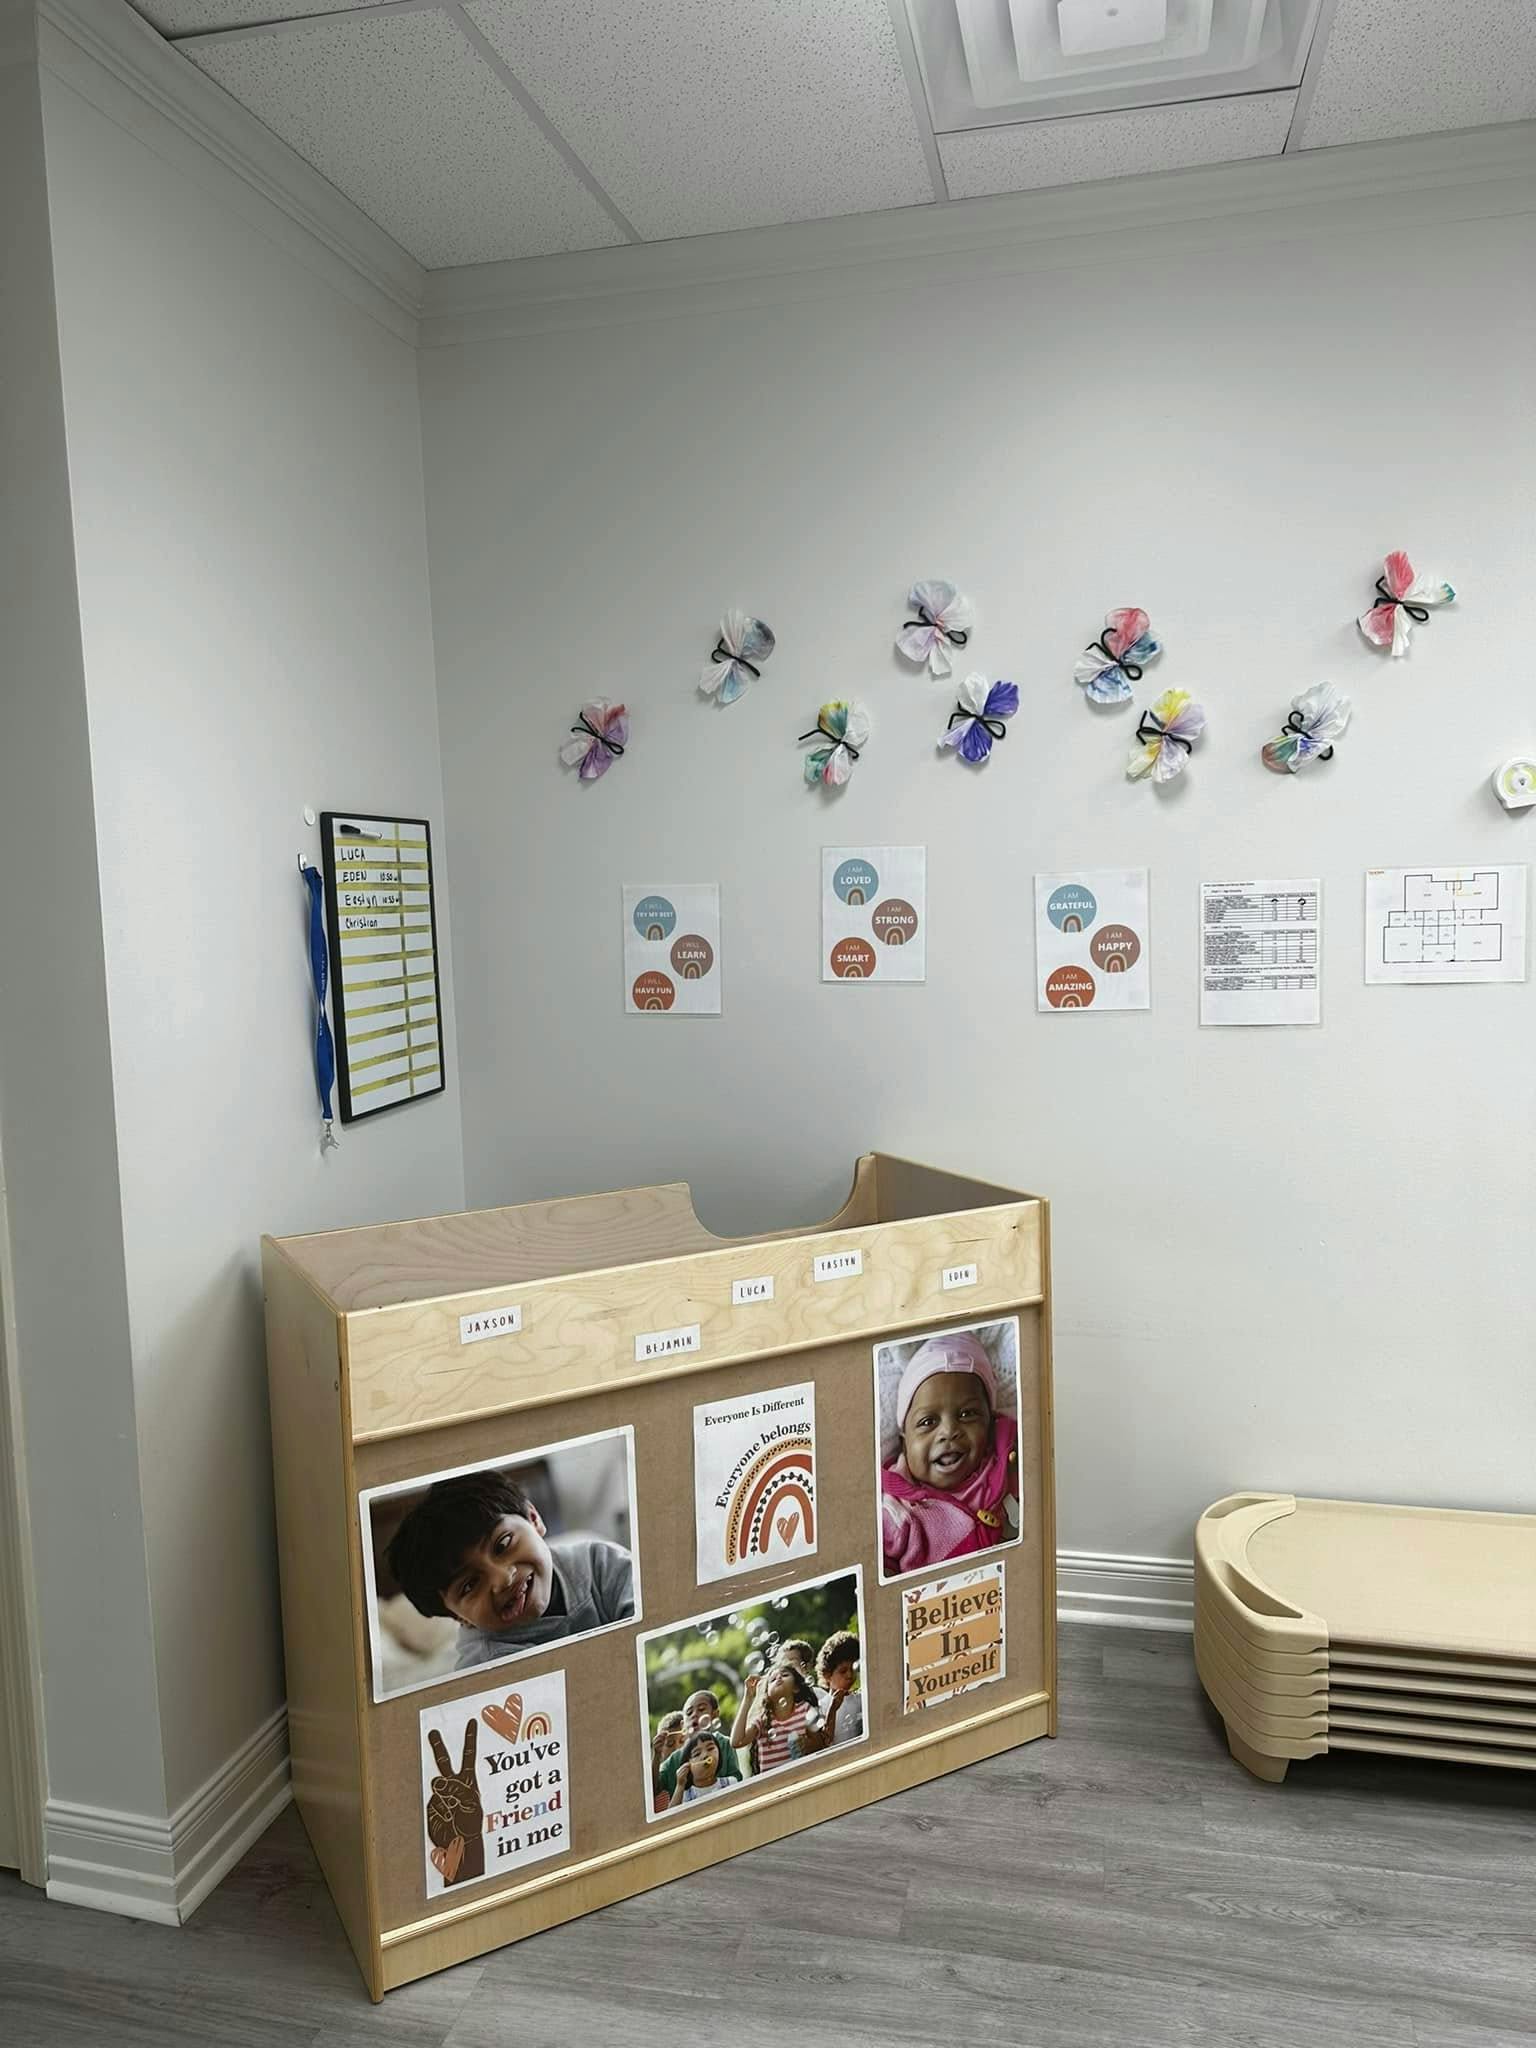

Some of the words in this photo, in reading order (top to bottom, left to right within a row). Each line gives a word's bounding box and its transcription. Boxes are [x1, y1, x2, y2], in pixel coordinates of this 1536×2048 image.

[341, 848, 366, 861] LUCA
[343, 870, 367, 882] EDEN
[840, 876, 872, 885] LOVED
[1049, 901, 1094, 911] GRATEFUL
[875, 915, 914, 925] STRONG
[1097, 942, 1133, 952] HAPPY
[677, 951, 707, 960] LEARN
[836, 954, 870, 963] SMART
[635, 987, 655, 995] HAVE
[656, 987, 673, 995] FUN
[1048, 982, 1093, 992] AMAZING
[740, 1285, 766, 1298] LUCA
[467, 1314, 515, 1334] JAXSON
[646, 1335, 693, 1355] BEJAMIN
[704, 1410, 750, 1426] Everyone
[751, 1406, 761, 1417] Is
[762, 1397, 805, 1414] Different
[715, 1442, 760, 1509] Everyone
[760, 1422, 812, 1445] belongs
[909, 1588, 998, 1633] Believe
[940, 1631, 971, 1658] In
[913, 1649, 998, 1697] Yourself
[484, 1740, 561, 1776] You've
[505, 1769, 542, 1804] got
[548, 1768, 562, 1785] a
[485, 1790, 562, 1834] Friend
[497, 1836, 521, 1858] in
[527, 1822, 563, 1847] me
